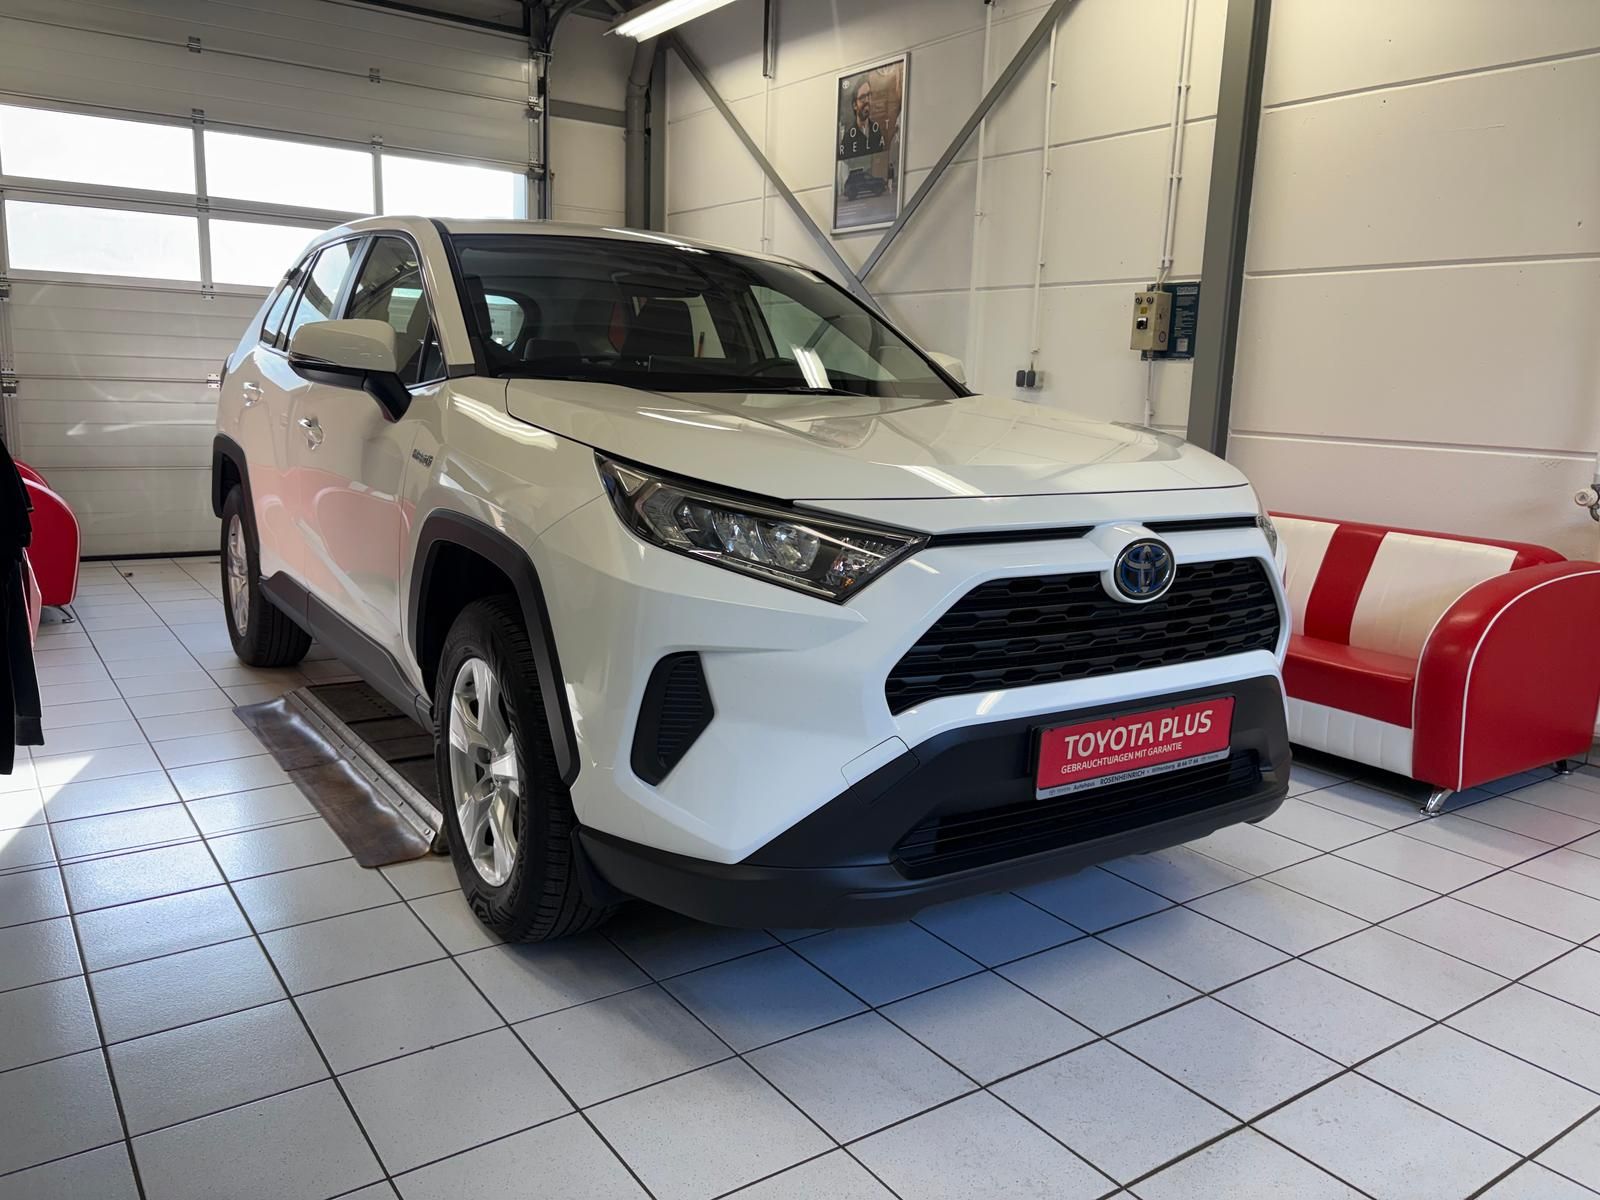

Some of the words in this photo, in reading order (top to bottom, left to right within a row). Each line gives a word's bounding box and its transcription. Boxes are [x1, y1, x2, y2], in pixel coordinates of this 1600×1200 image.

[839, 117, 900, 140] OYOTA
[839, 133, 900, 155] RELAX
[1064, 721, 1153, 760] TOYOTA
[1158, 709, 1214, 742] PLUS
[1061, 753, 1134, 774] GEBRAUCHTWAGEN
[1134, 748, 1147, 760] MIT
[1147, 741, 1183, 757] GARANTIE
[1100, 769, 1146, 785] ROSENHEINRICH
